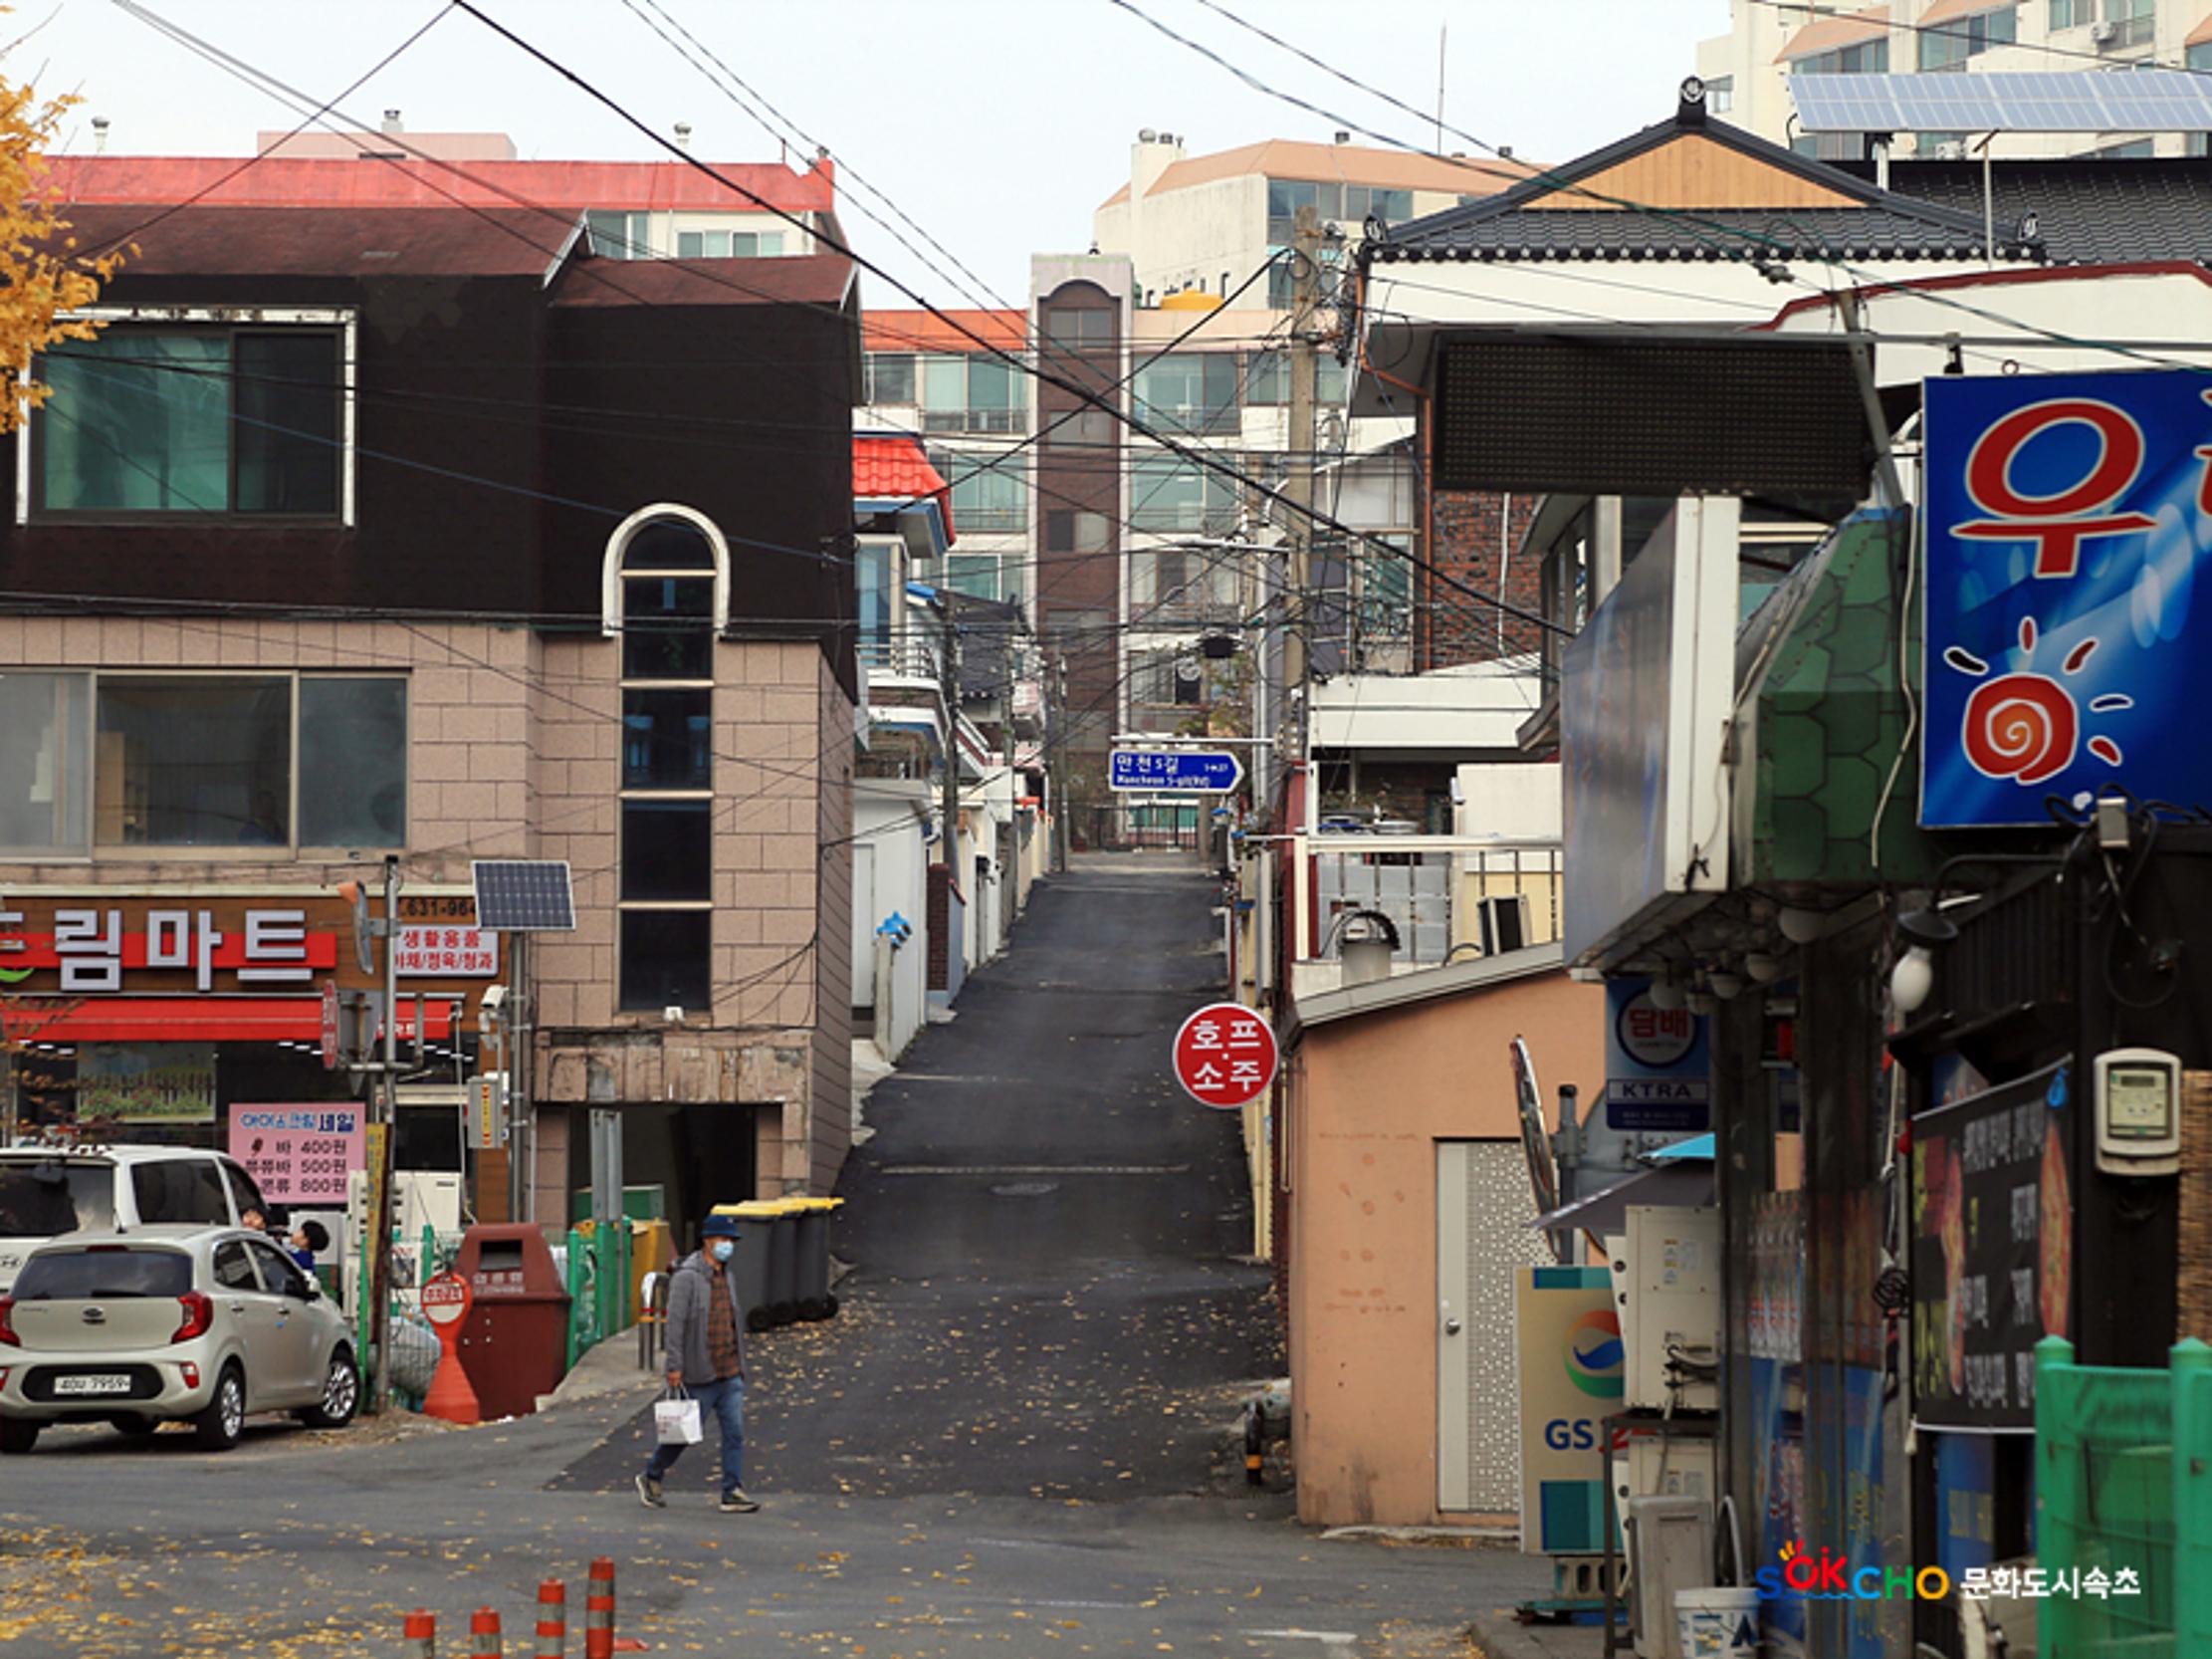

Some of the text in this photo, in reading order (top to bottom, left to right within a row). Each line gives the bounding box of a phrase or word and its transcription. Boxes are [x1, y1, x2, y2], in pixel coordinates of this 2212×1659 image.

[1949, 390, 2212, 579] 우
[404, 929, 480, 949] 생활용품
[1629, 1009, 1689, 1038] 담배
[1622, 1083, 1691, 1097] KTRA
[318, 1112, 355, 1133] 세일
[301, 1139, 346, 1154] 400원
[301, 1159, 346, 1173] 500원
[301, 1178, 346, 1193] 800원
